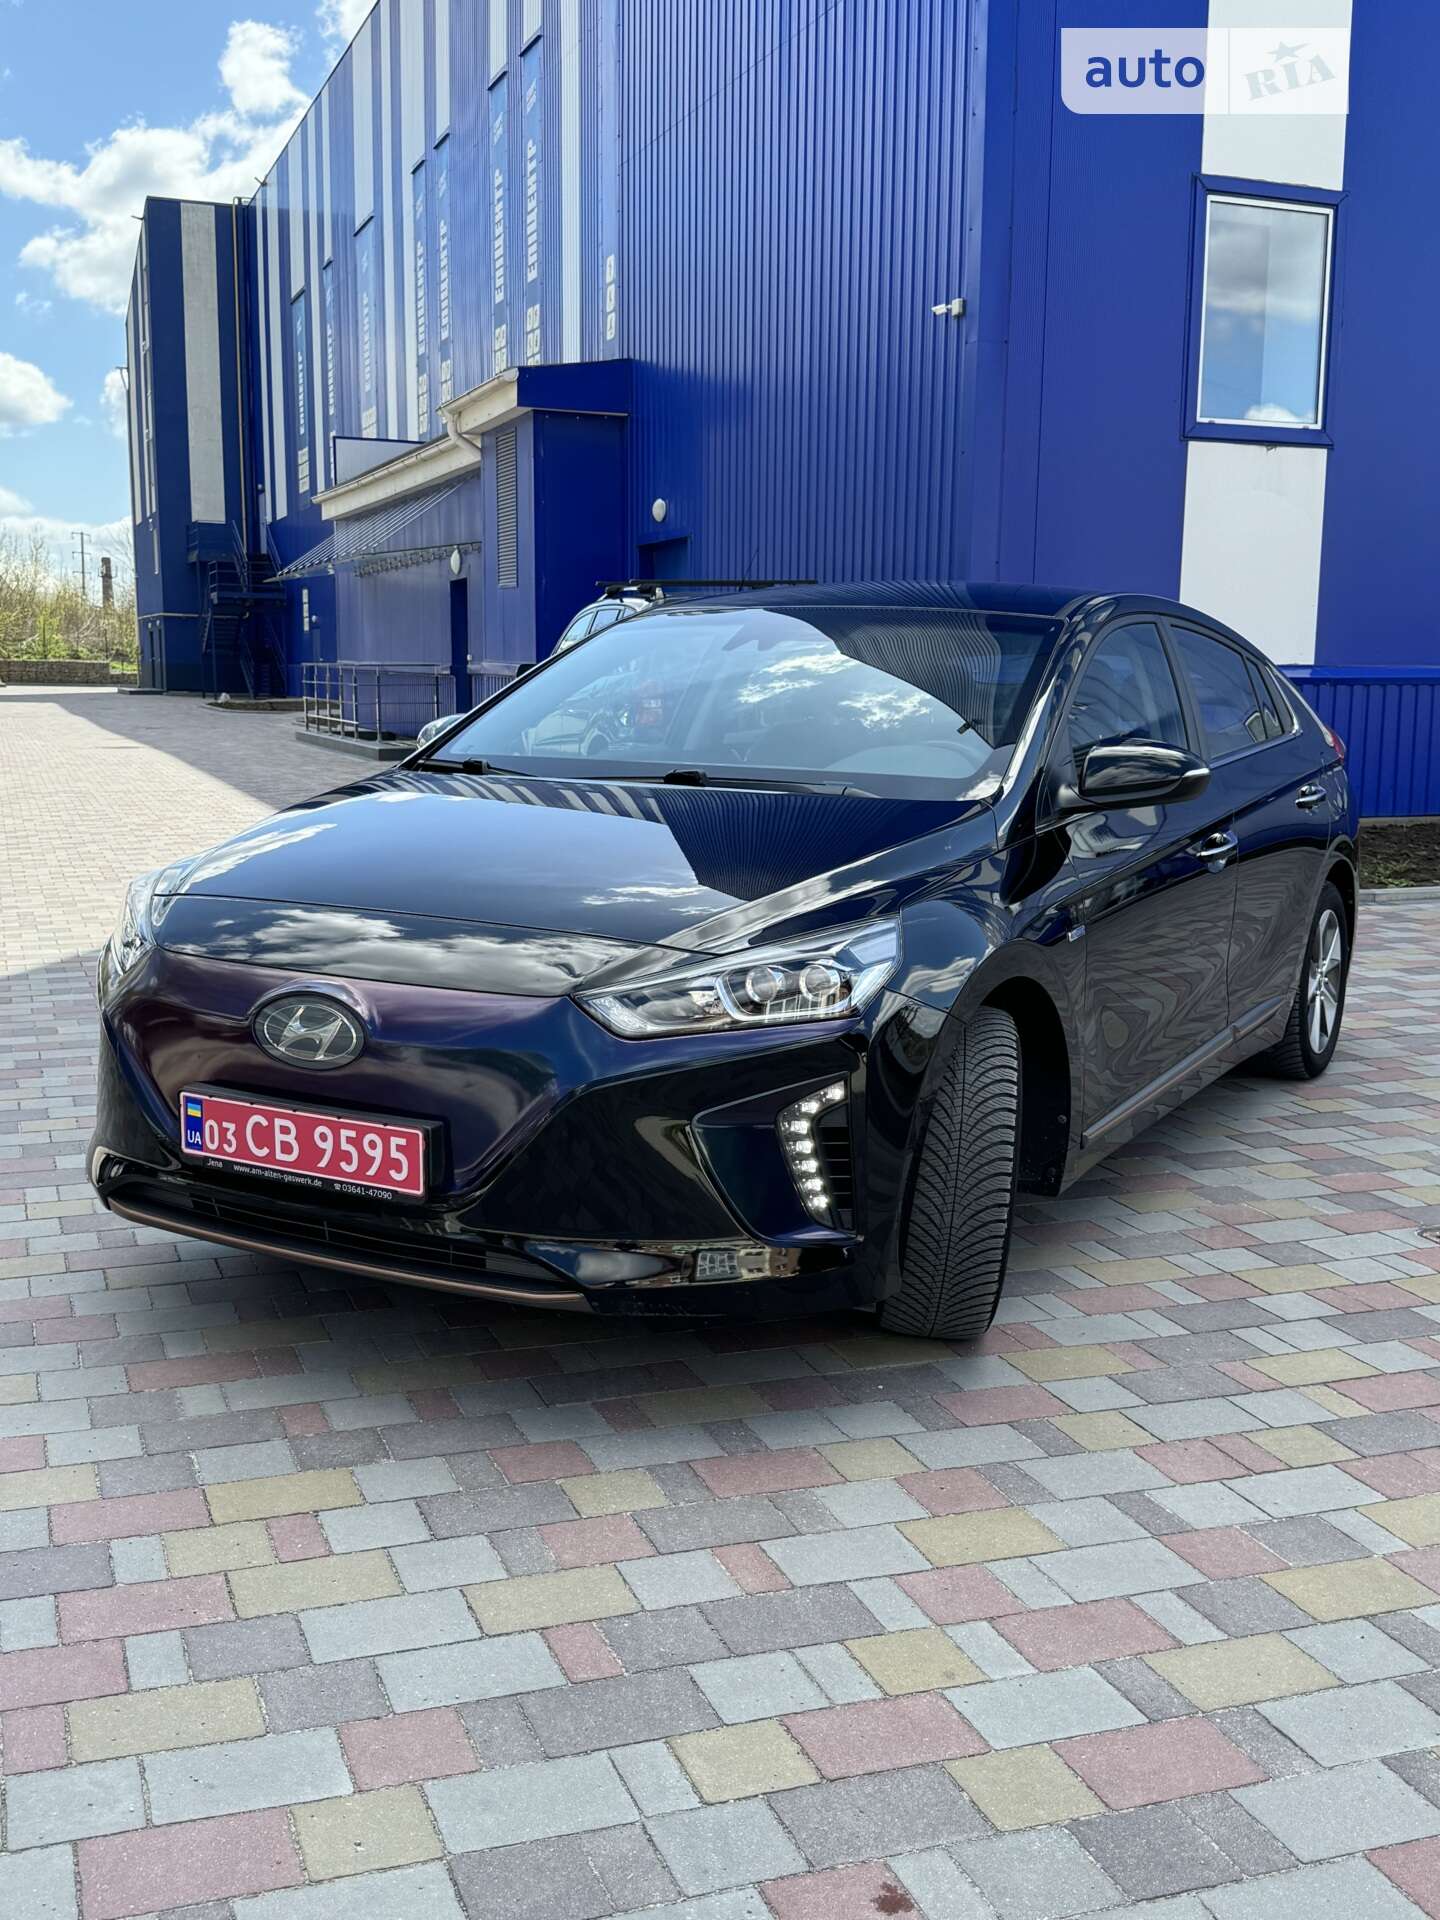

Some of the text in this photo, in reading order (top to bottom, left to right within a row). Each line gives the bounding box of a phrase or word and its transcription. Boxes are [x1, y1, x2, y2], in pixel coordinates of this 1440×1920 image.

[187, 1129, 202, 1145] UA
[204, 1114, 409, 1181] 03 CB 9595
[207, 1158, 223, 1168] Jena
[342, 1184, 392, 1199] 03641-47090
